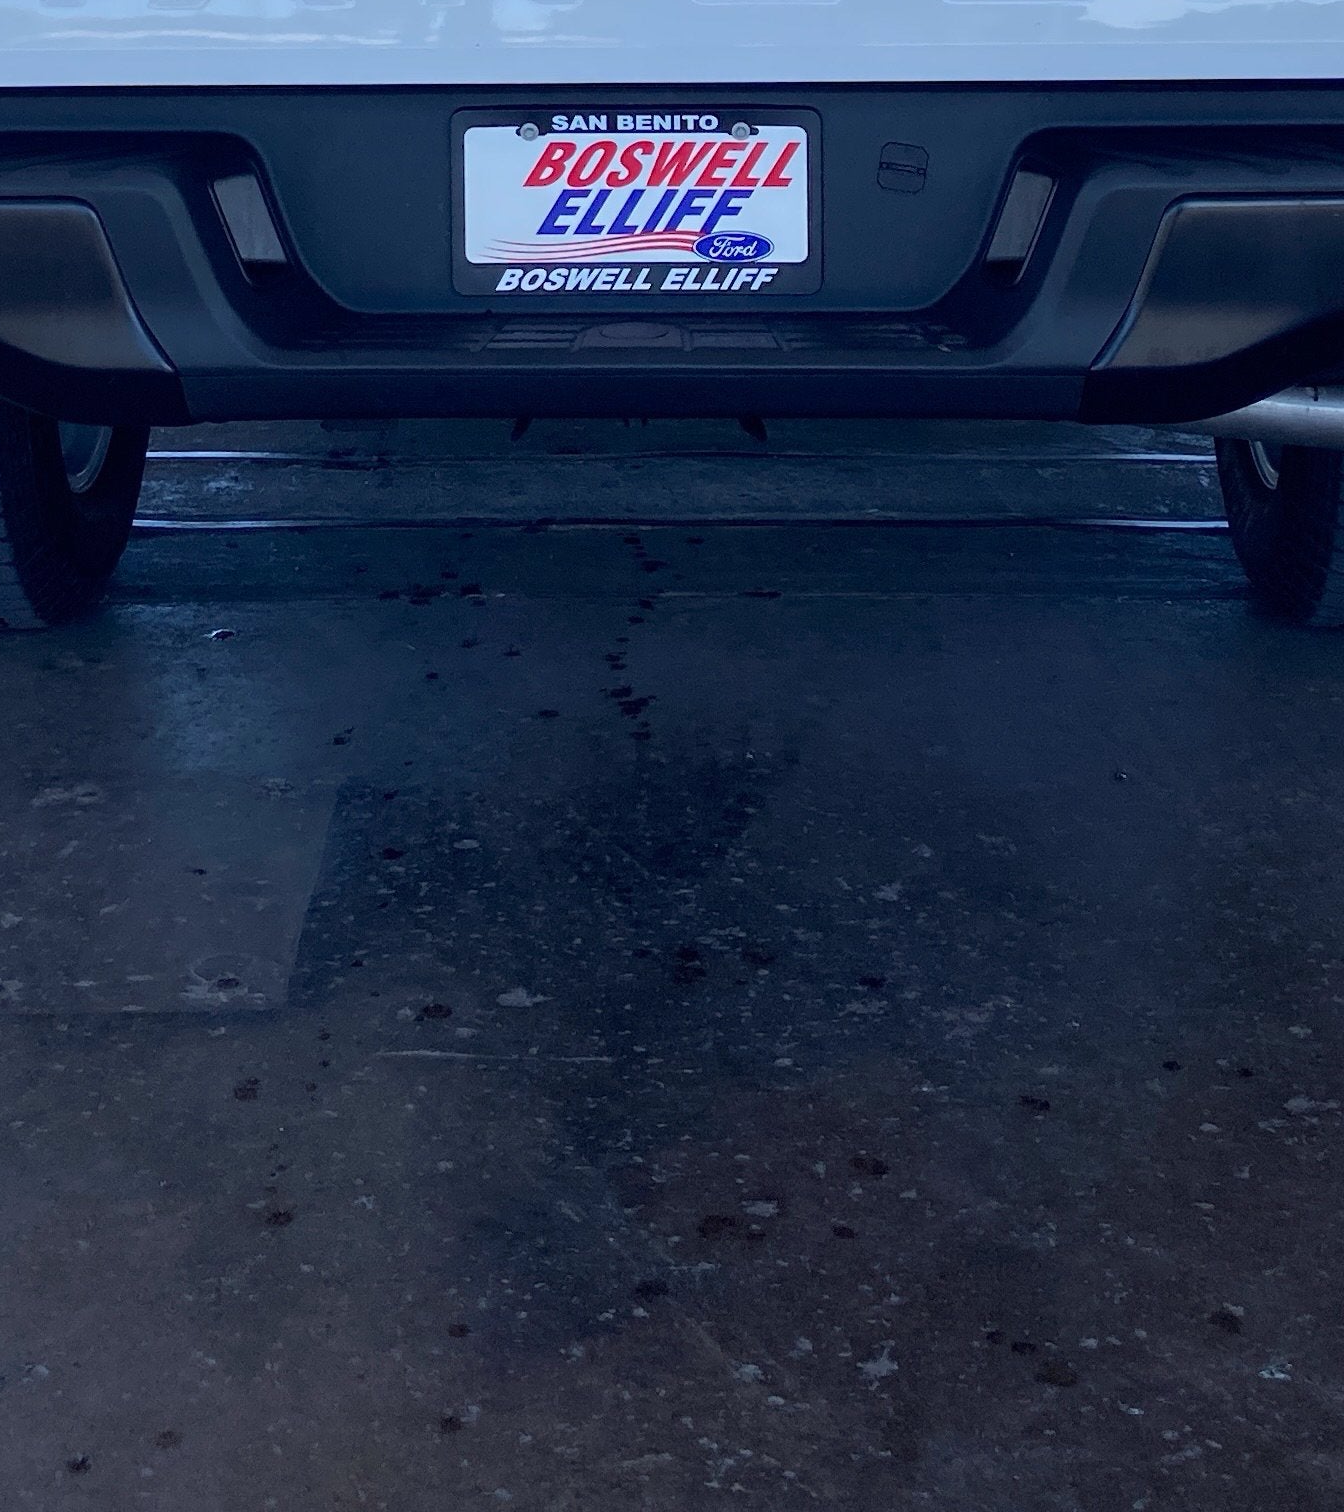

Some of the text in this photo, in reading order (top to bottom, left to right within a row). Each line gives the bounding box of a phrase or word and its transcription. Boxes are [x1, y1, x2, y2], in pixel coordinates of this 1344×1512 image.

[551, 114, 719, 131] SAN BENITO
[522, 140, 801, 188] BOSWELL
[536, 189, 755, 236] ELLIFF
[708, 236, 758, 258] Ford
[495, 268, 778, 292] BOSWELL ELLIFF
